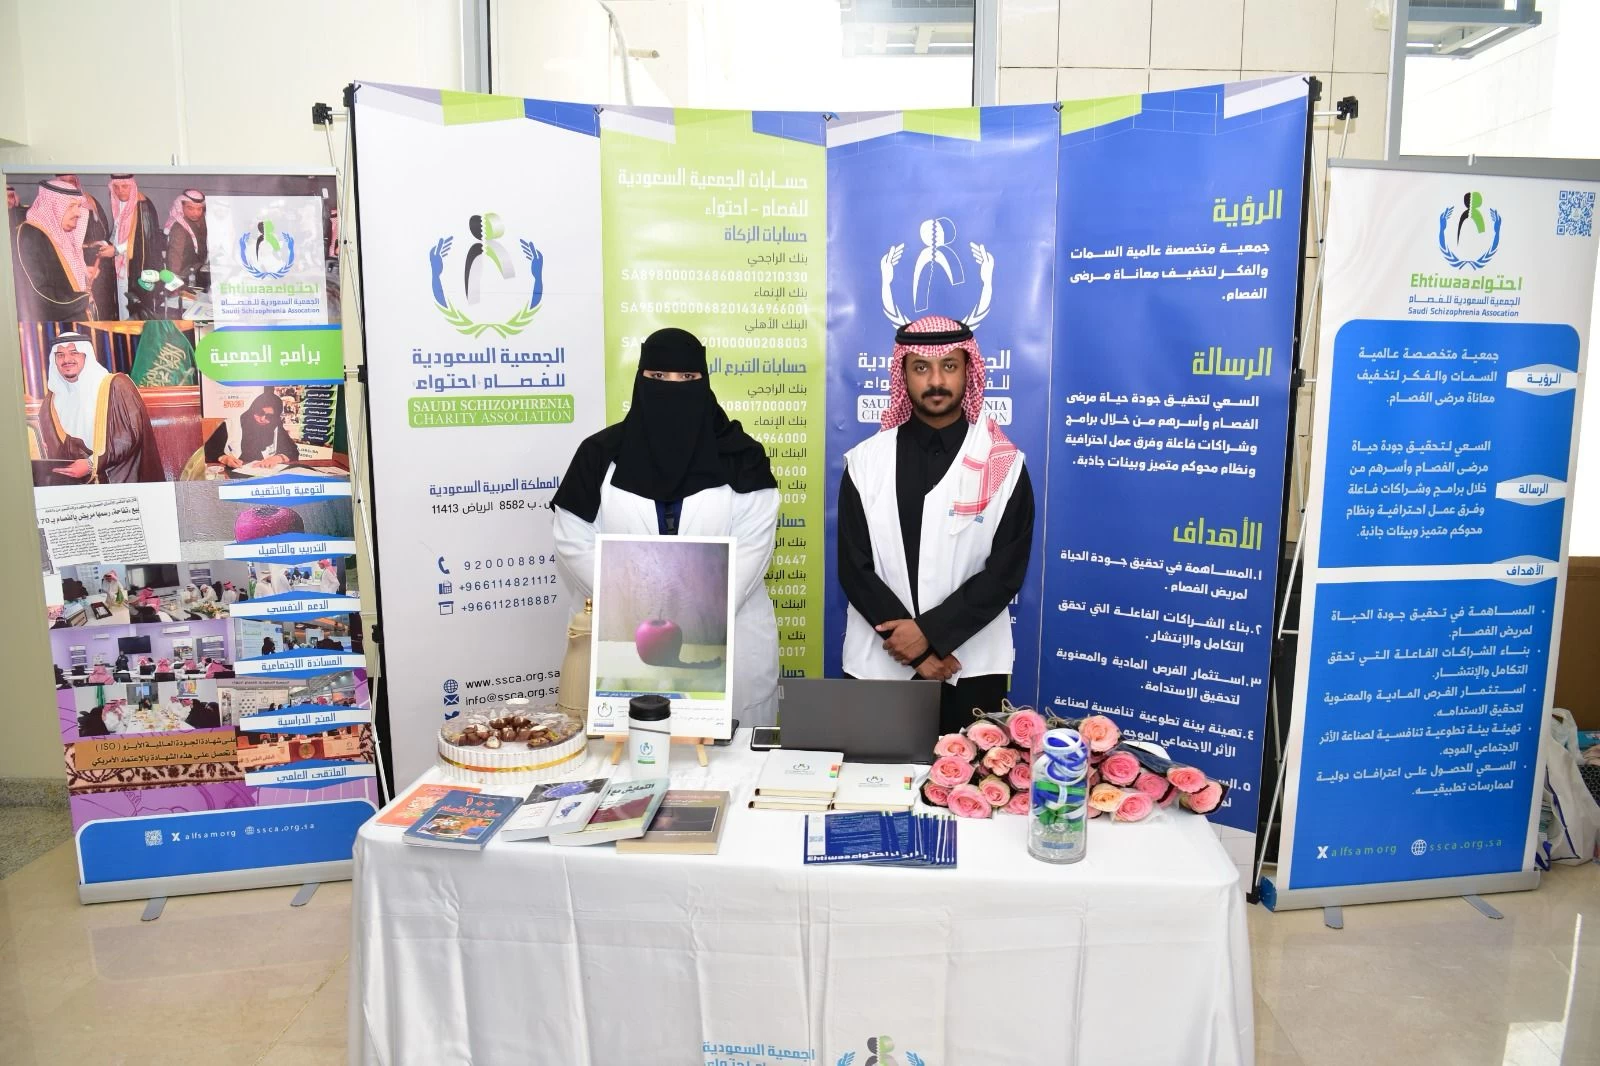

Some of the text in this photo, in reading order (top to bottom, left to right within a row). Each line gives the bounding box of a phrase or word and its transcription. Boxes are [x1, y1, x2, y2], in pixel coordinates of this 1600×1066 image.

[618, 167, 808, 192] حسابات الجمعية السعودية
[705, 196, 808, 218] للفصام احتواء
[1212, 188, 1283, 228] الرؤية
[724, 225, 808, 244] حسابات الزكاة
[1070, 242, 1270, 260] جمعية متخصصة عالمية السمات
[747, 252, 808, 267] بنك الراجحي
[1070, 264, 1269, 284] والفكر لتخفيف معاناة مرضى
[1411, 273, 1471, 290] Ehtiwaa
[1471, 274, 1523, 293] احتواء
[754, 287, 808, 301] بنك الإنماء
[1408, 294, 1521, 308] الجمعية السعودية للفصام
[1408, 307, 1519, 317] Saudi Schizophrenia Assocation
[744, 318, 808, 334] البنك الأهلي
[210, 344, 321, 367] برامج الجمعية
[412, 347, 565, 368] الجمعية السعودية
[724, 358, 759, 376] التبرع
[762, 357, 807, 376] حسابات
[1192, 346, 1273, 381] الرسالة
[415, 373, 566, 392] للفصام احتواء
[1357, 368, 1498, 384] السمات والفكر لتخفيف
[1527, 373, 1562, 387] الرؤية
[747, 384, 807, 398] بنك الراجحي
[413, 398, 571, 412] SAUDI SCHIZOPHRENIA
[1066, 391, 1260, 412] السعي لتحقيق جودة حياة مرضى
[1435, 392, 1495, 406] معاناة مرضى
[413, 410, 571, 425] CHARITY ASSOCIATION
[754, 416, 807, 430] بنك الإنماء
[781, 448, 807, 459] البنك
[1350, 459, 1489, 477] مرضى الفصام وأسرهم من
[251, 484, 325, 498] التوعية والتثقيف
[429, 476, 560, 496] المملكة العربية السعودية
[1518, 483, 1549, 497] الرسالة
[431, 499, 524, 515] 8582 الرياض 11413
[1173, 516, 1263, 551] الأهداف
[1450, 525, 1483, 538] محوكم
[299, 543, 327, 554] التدريب
[1060, 549, 1182, 576] في تحقيق جودة الحياة
[1506, 563, 1544, 577] الأهداف
[459, 574, 557, 591] +966114821112
[1210, 587, 1248, 600] لمريض
[307, 599, 329, 610] الدعم
[781, 599, 806, 610] البنك
[1500, 625, 1533, 638] لمريض
[307, 656, 343, 667] المساندة
[1327, 645, 1530, 666] بناء الشراكات الفاعلة التي تحقق
[465, 670, 561, 689] www.ssca.org.sa
[1054, 695, 1180, 727] تطوعية تنافسية لصناعة
[278, 713, 336, 727] المنح الدراسية
[1319, 730, 1339, 745] الأثر
[1341, 729, 1374, 741] لصناعة
[1376, 727, 1424, 742] تنافسية
[1425, 725, 1465, 739] تطوعية
[1473, 741, 1519, 759] الاجتماعي
[311, 767, 347, 779] الملتقى
[1316, 760, 1516, 783] السعي للحصول على اعترافات دولية
[1468, 780, 1514, 792] لممارسات
